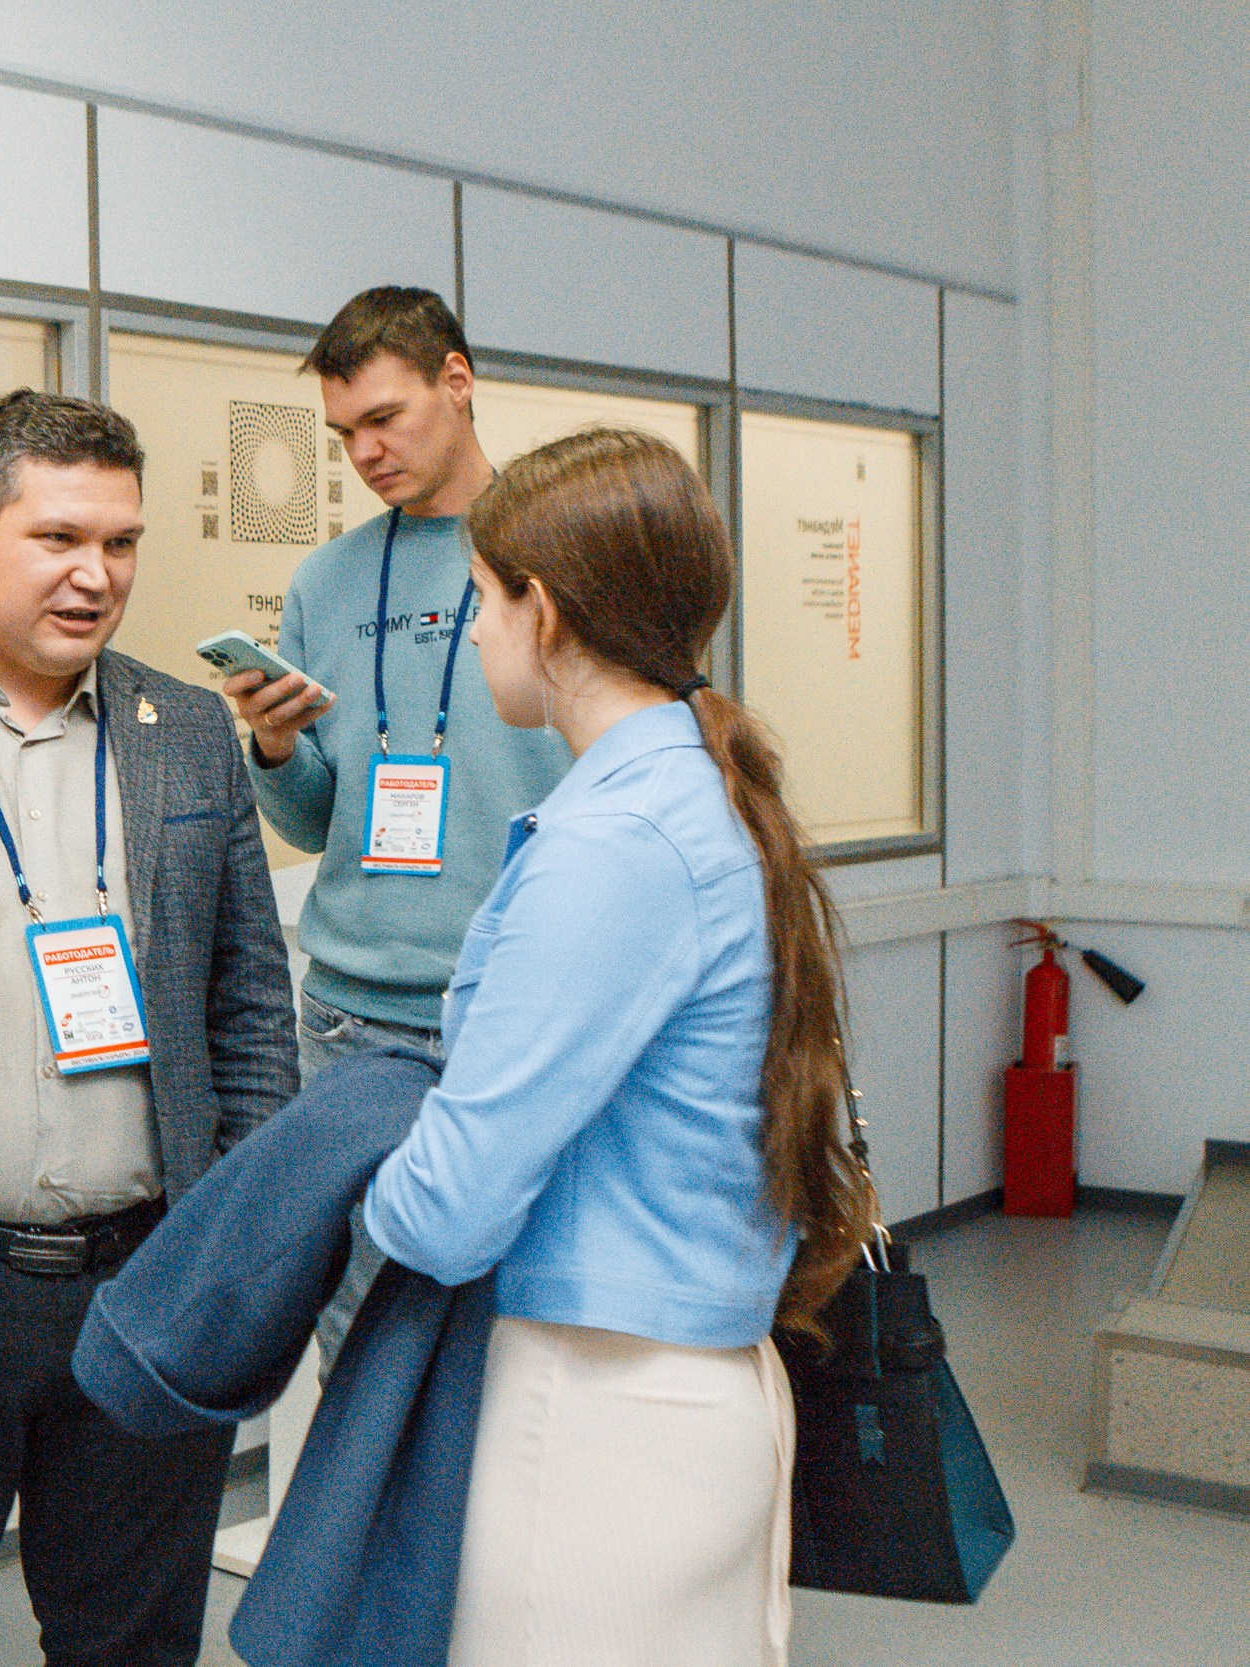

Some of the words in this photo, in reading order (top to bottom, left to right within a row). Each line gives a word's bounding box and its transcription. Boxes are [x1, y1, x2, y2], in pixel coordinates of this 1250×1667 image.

[44, 946, 115, 963] РАБОТОДАТЕЛЬ
[64, 963, 104, 974] РУССКИХ
[70, 974, 101, 985] АНТОН
